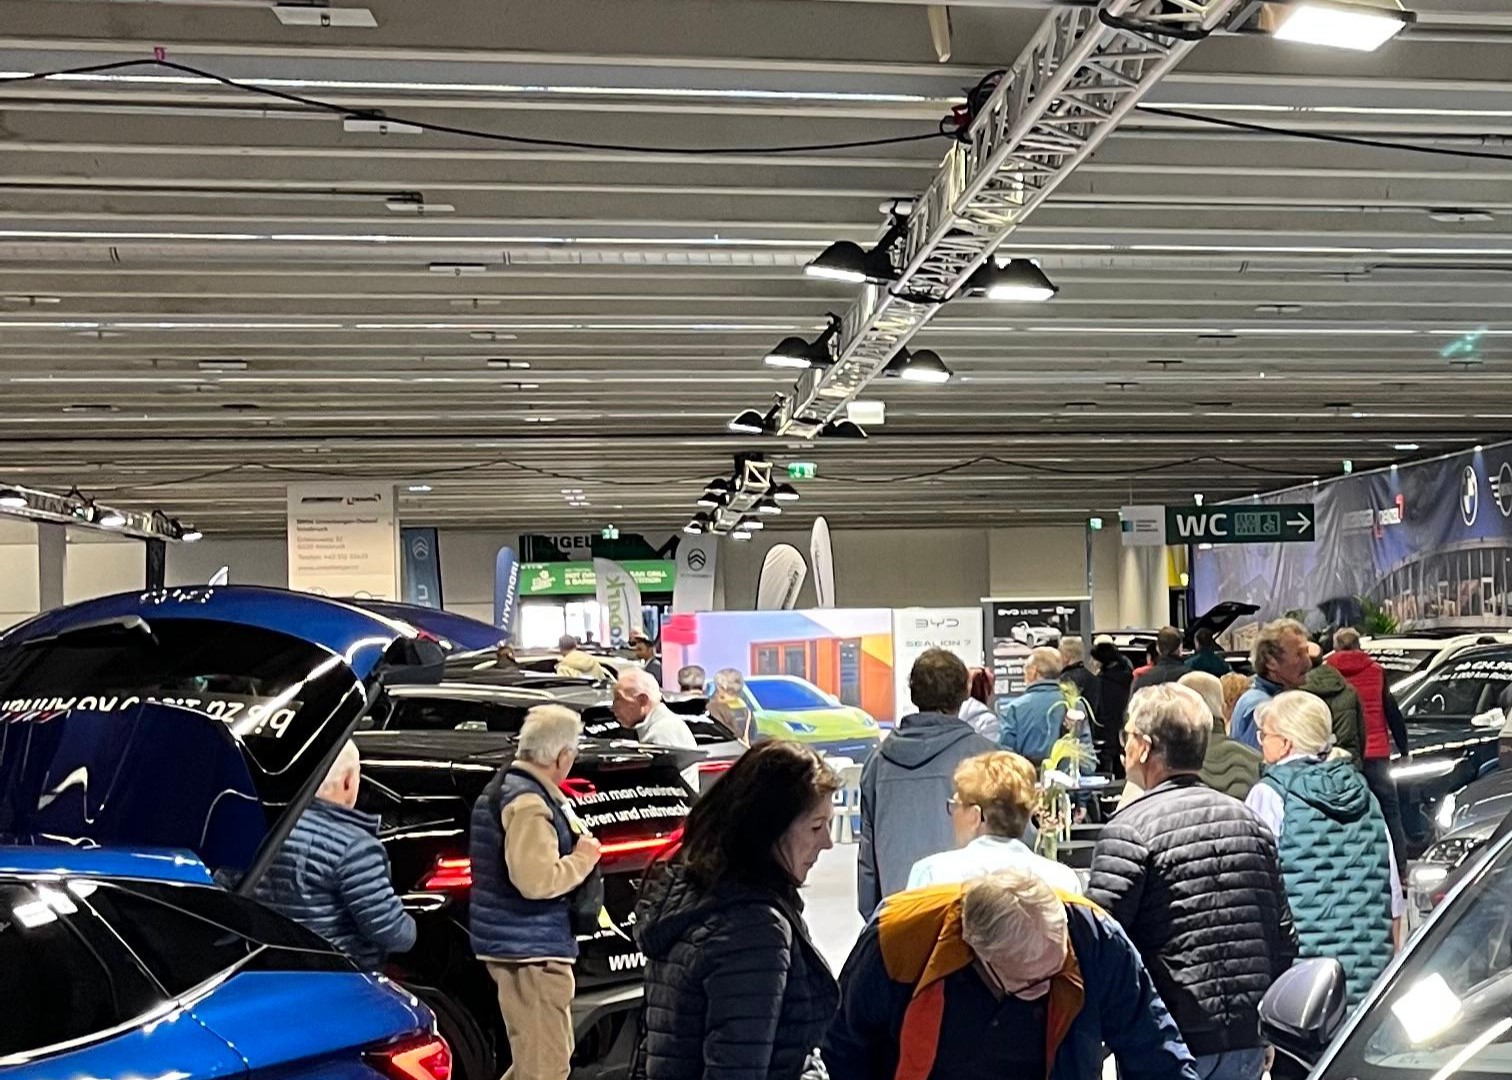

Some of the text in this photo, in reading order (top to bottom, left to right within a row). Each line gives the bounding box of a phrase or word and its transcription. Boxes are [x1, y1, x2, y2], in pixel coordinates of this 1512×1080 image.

[1176, 513, 1228, 537] WC
[915, 618, 960, 629] BYD
[575, 791, 610, 806] kann
[609, 787, 639, 800] man
[615, 806, 641, 822] und
